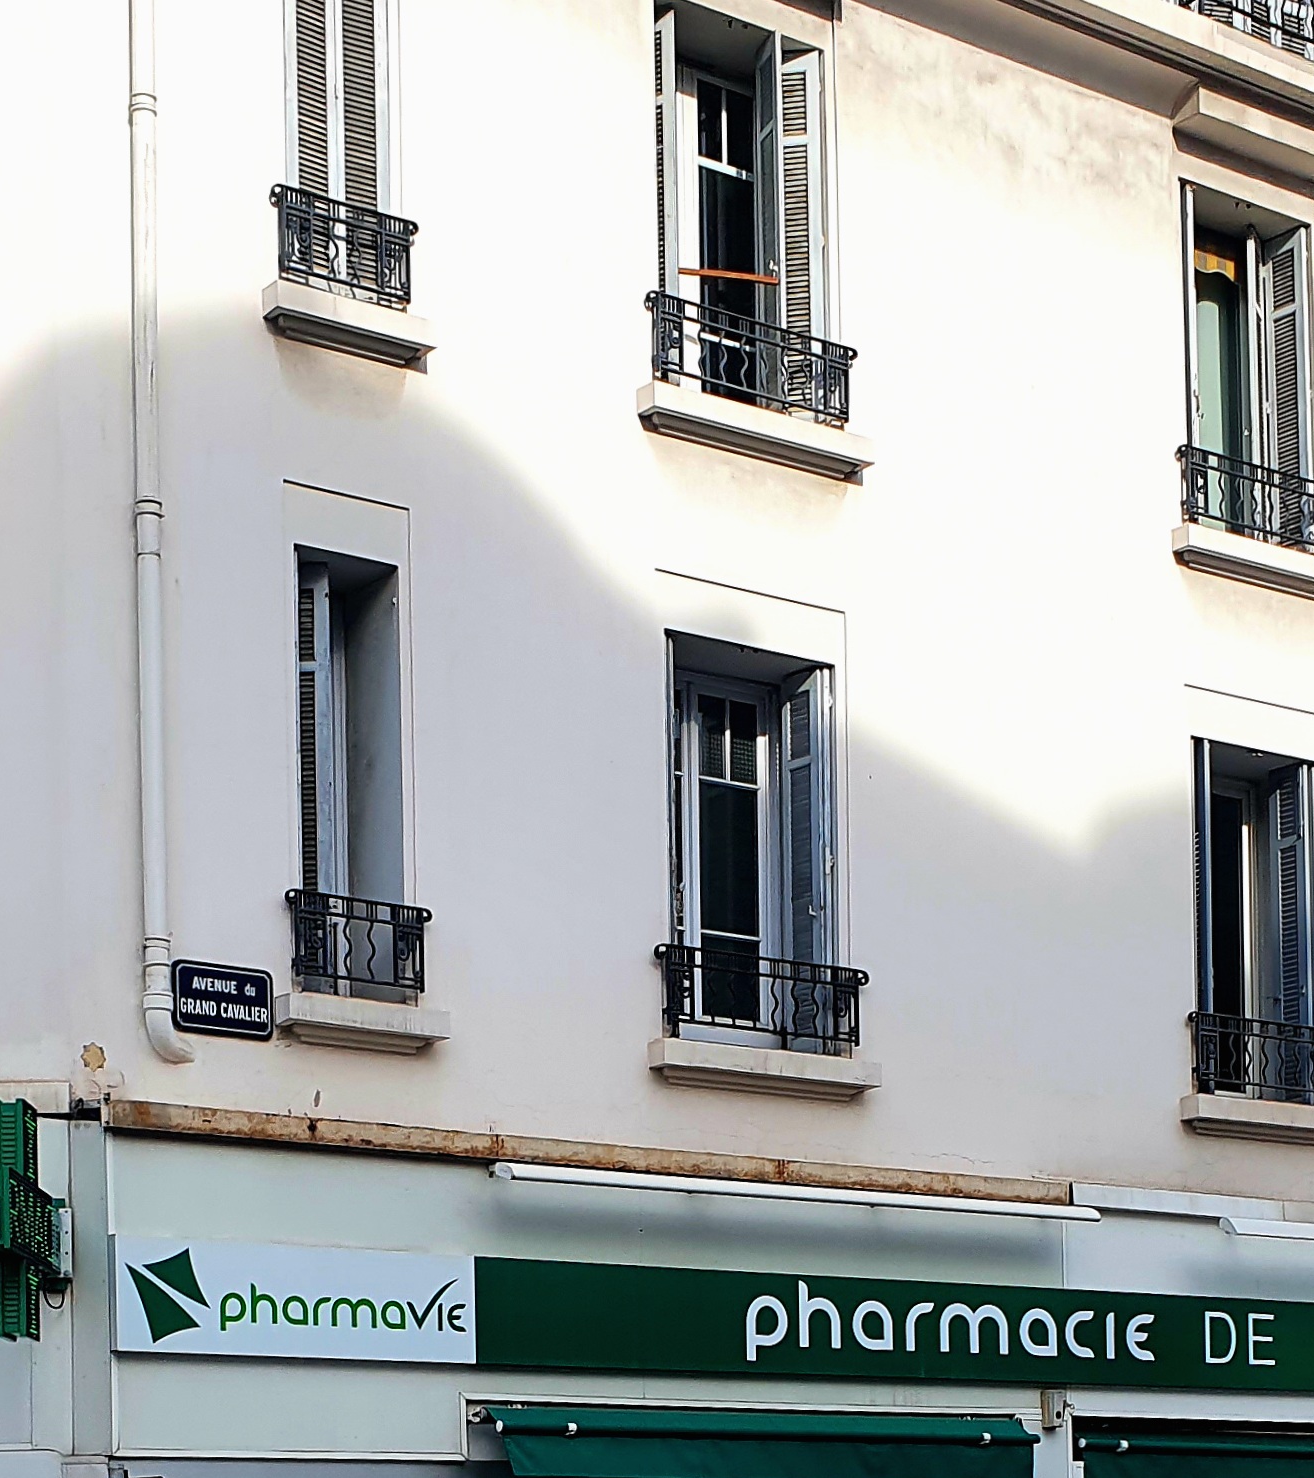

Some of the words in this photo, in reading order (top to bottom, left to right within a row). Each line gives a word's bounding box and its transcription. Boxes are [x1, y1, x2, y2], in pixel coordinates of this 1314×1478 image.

[192, 976, 238, 994] AVENUE
[244, 984, 256, 997] du
[180, 997, 217, 1017] GRAND
[221, 1004, 268, 1023] CAVALIER
[1203, 1311, 1276, 1368] DE
